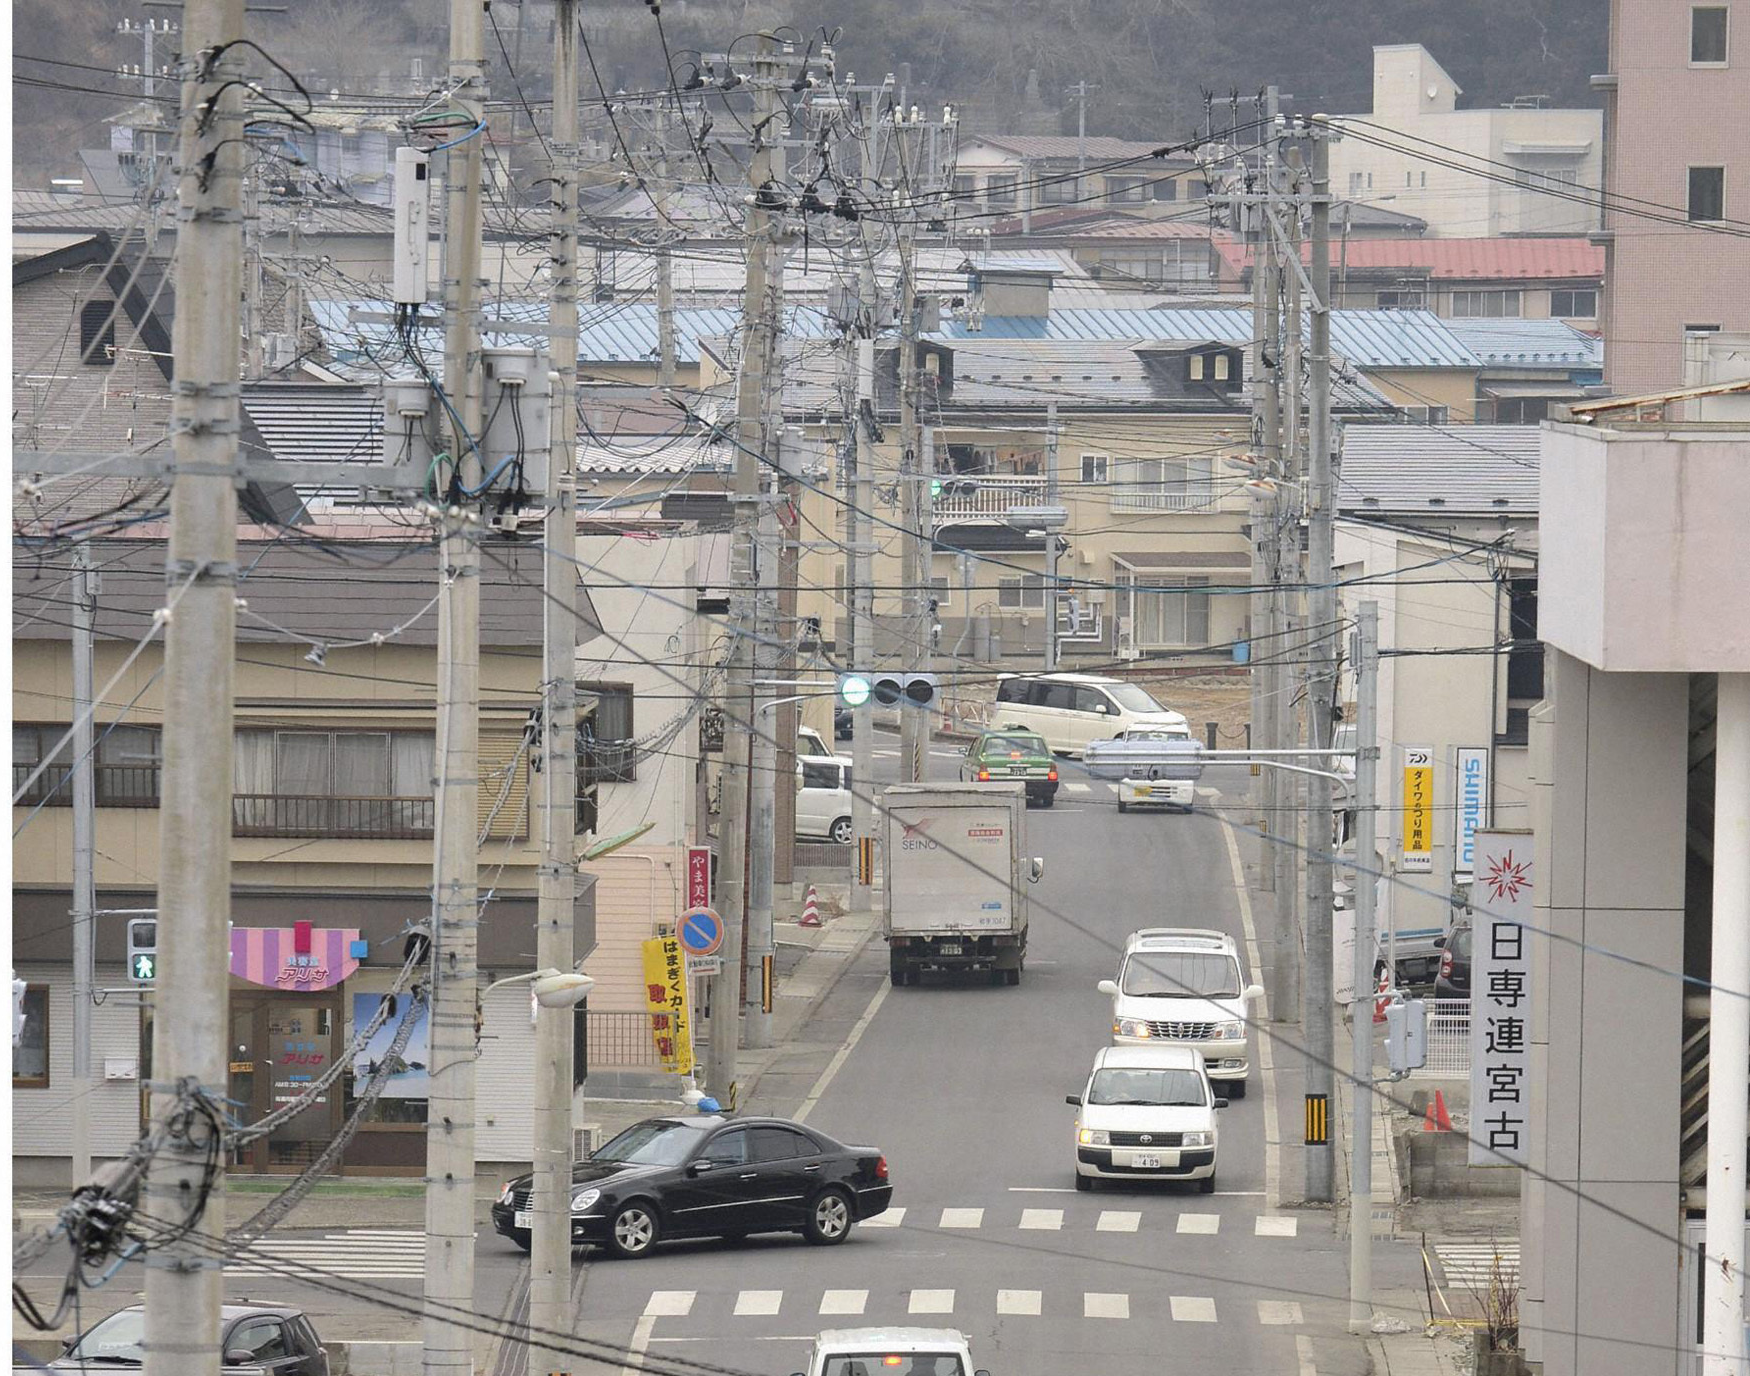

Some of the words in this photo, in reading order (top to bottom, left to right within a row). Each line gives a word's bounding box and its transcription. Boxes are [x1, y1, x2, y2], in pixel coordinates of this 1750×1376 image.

[1412, 770, 1423, 850] ダイワのつり用品
[902, 840, 938, 851] SEINO
[274, 967, 329, 983] アリサ
[1484, 922, 1526, 1150] 日専連宮古
